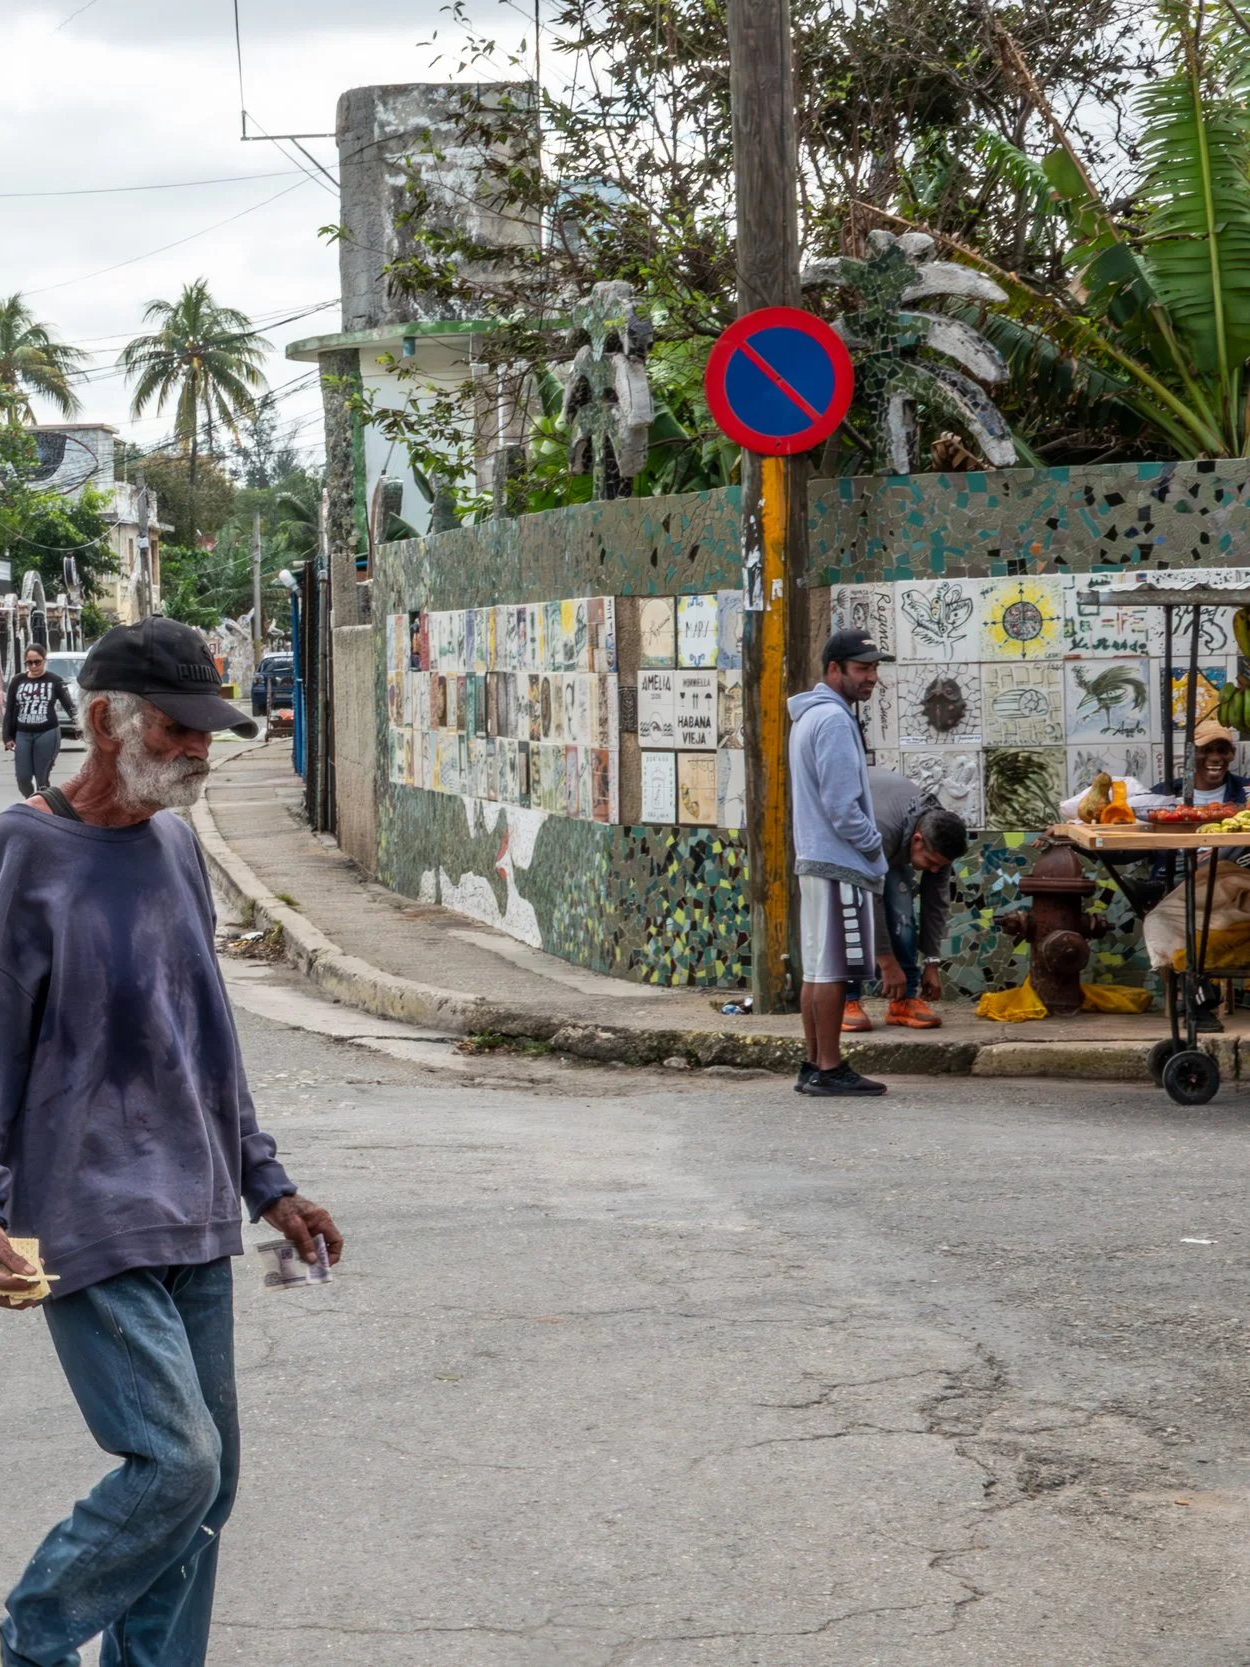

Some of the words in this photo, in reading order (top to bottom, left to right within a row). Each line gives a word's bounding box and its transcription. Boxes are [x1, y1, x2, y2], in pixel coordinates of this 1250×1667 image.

[870, 592, 893, 654] Regina
[642, 675, 671, 691] AMELIA
[677, 715, 712, 729] HABANA
[682, 731, 707, 745] VIEJA
